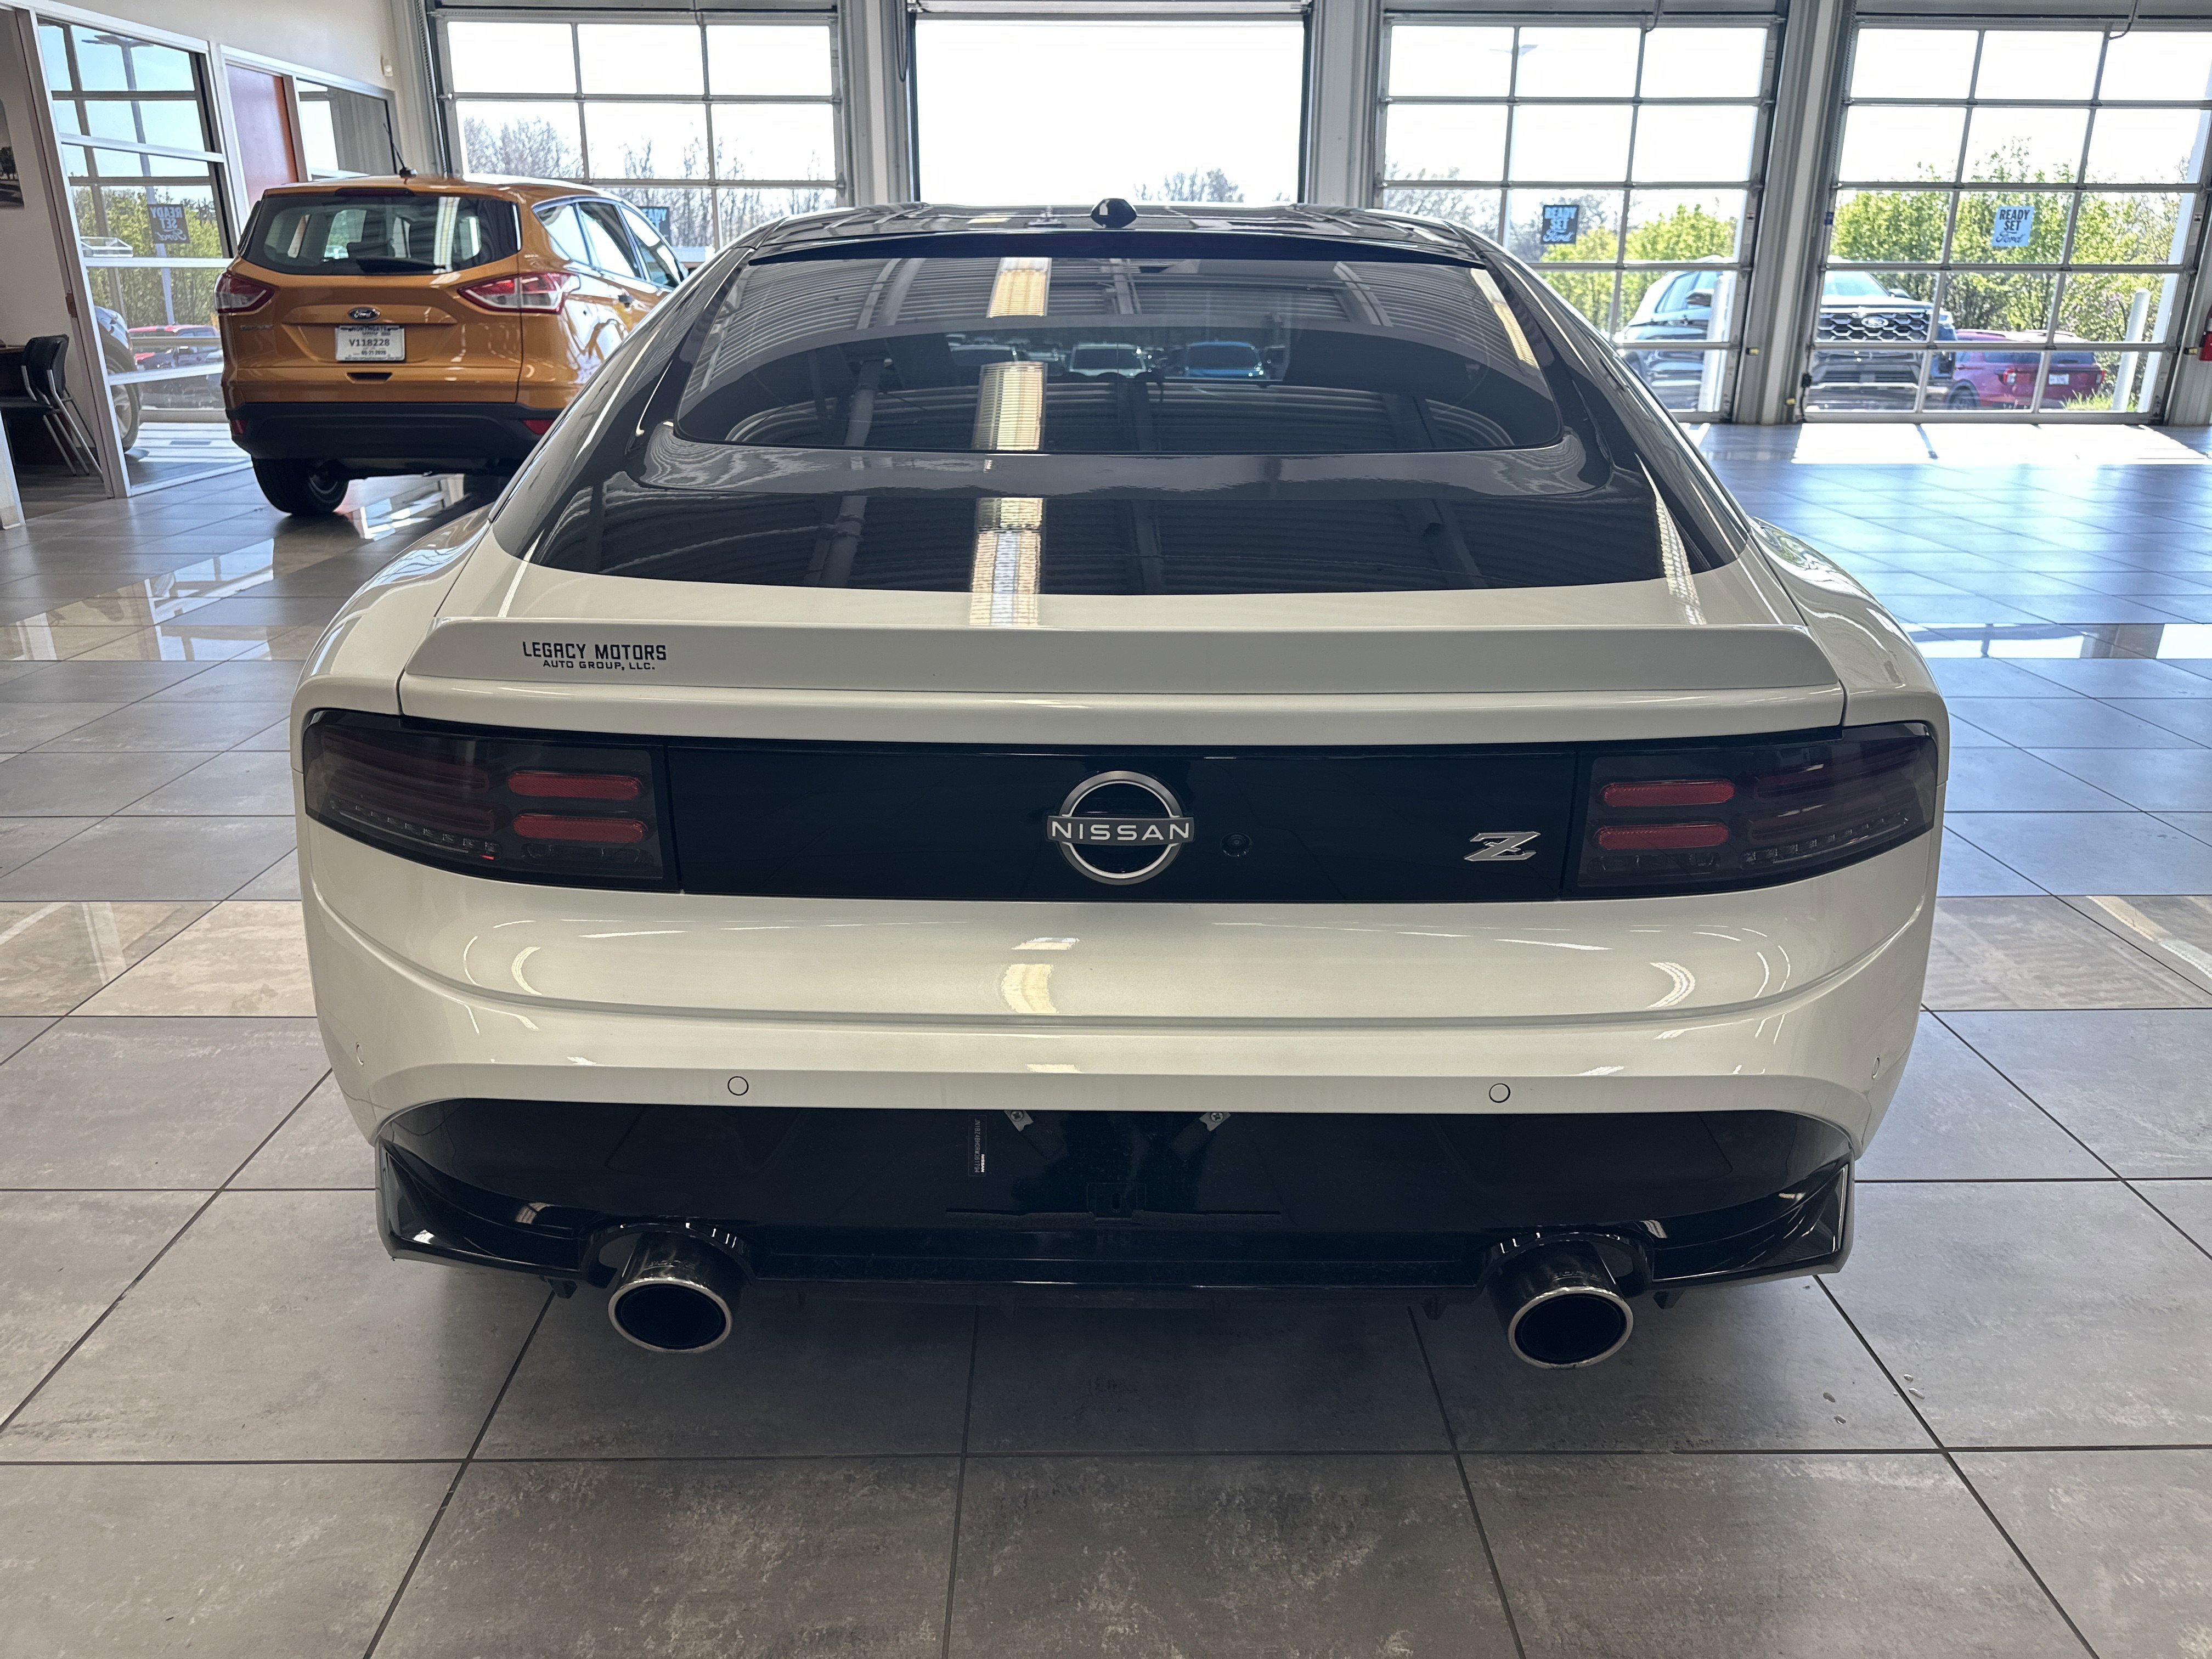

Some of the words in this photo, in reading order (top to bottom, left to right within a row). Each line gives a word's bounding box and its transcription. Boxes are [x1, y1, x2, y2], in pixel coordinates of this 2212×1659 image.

[641, 208, 667, 221] EADY
[1544, 207, 1577, 219] READY
[1999, 209, 2030, 221] READY
[1550, 219, 1570, 229] SET
[2004, 220, 2022, 231] SET
[1543, 229, 1576, 242] Ford
[1995, 231, 2027, 243] Ford
[349, 338, 390, 347] V118228
[522, 641, 586, 659] LEGACY
[595, 644, 667, 661] MOTORS
[543, 660, 574, 668] AUTO
[579, 661, 625, 670] GROUP,
[1051, 821, 1189, 840] NISSAN
[1464, 831, 1541, 861] Z
